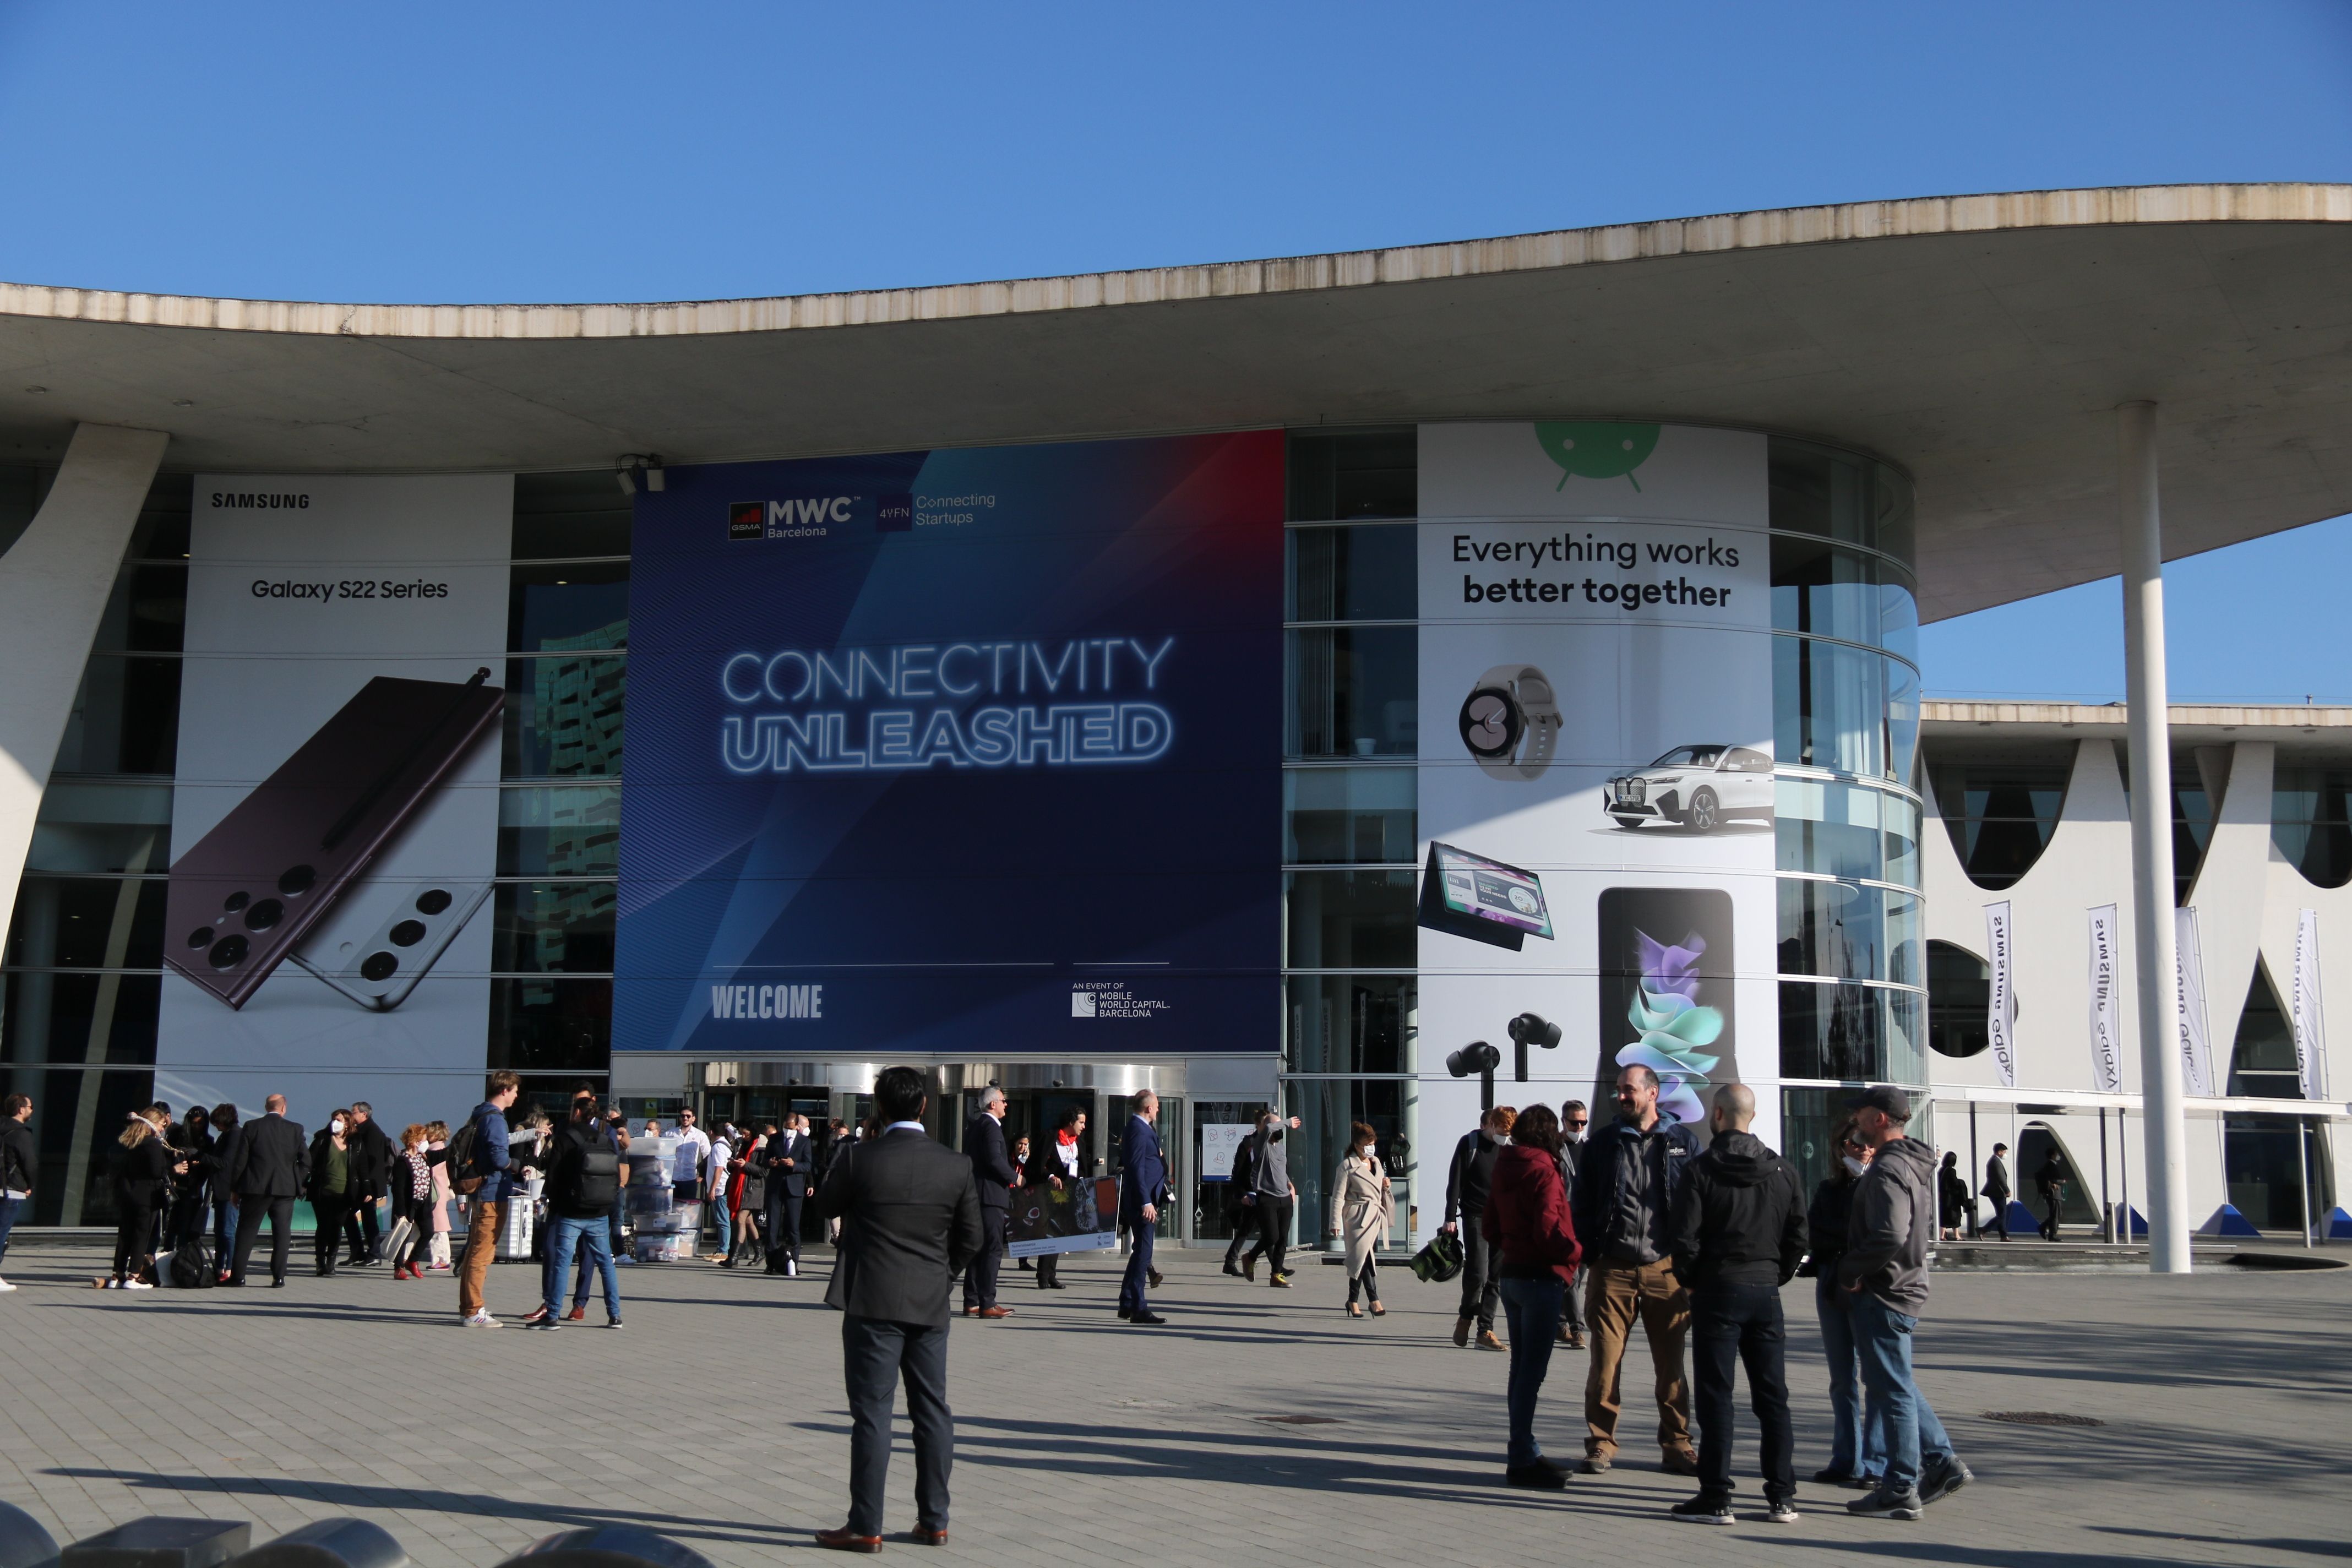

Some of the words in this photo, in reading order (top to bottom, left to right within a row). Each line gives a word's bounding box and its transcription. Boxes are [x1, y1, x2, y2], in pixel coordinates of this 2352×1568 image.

[211, 492, 309, 509] SAMSUNG
[916, 493, 995, 509] Connecting
[880, 508, 909, 518] 4YFN
[916, 511, 973, 526] Startups
[768, 526, 826, 538] Barcelona
[1453, 533, 1636, 570] Everything
[1646, 537, 1739, 568] works
[251, 580, 335, 603] Galaxy
[338, 580, 375, 598] S22
[380, 579, 448, 598] Series
[1464, 575, 1575, 603] better
[1581, 576, 1731, 611] together
[722, 638, 1173, 702] CONNECTIVITY
[723, 704, 1173, 771] UNLEASHED
[712, 984, 823, 1019] WELCOME
[1099, 992, 1132, 1000] MOBILE
[1099, 1000, 1130, 1009] WORLD
[1099, 1009, 1151, 1017] BARCELONA
